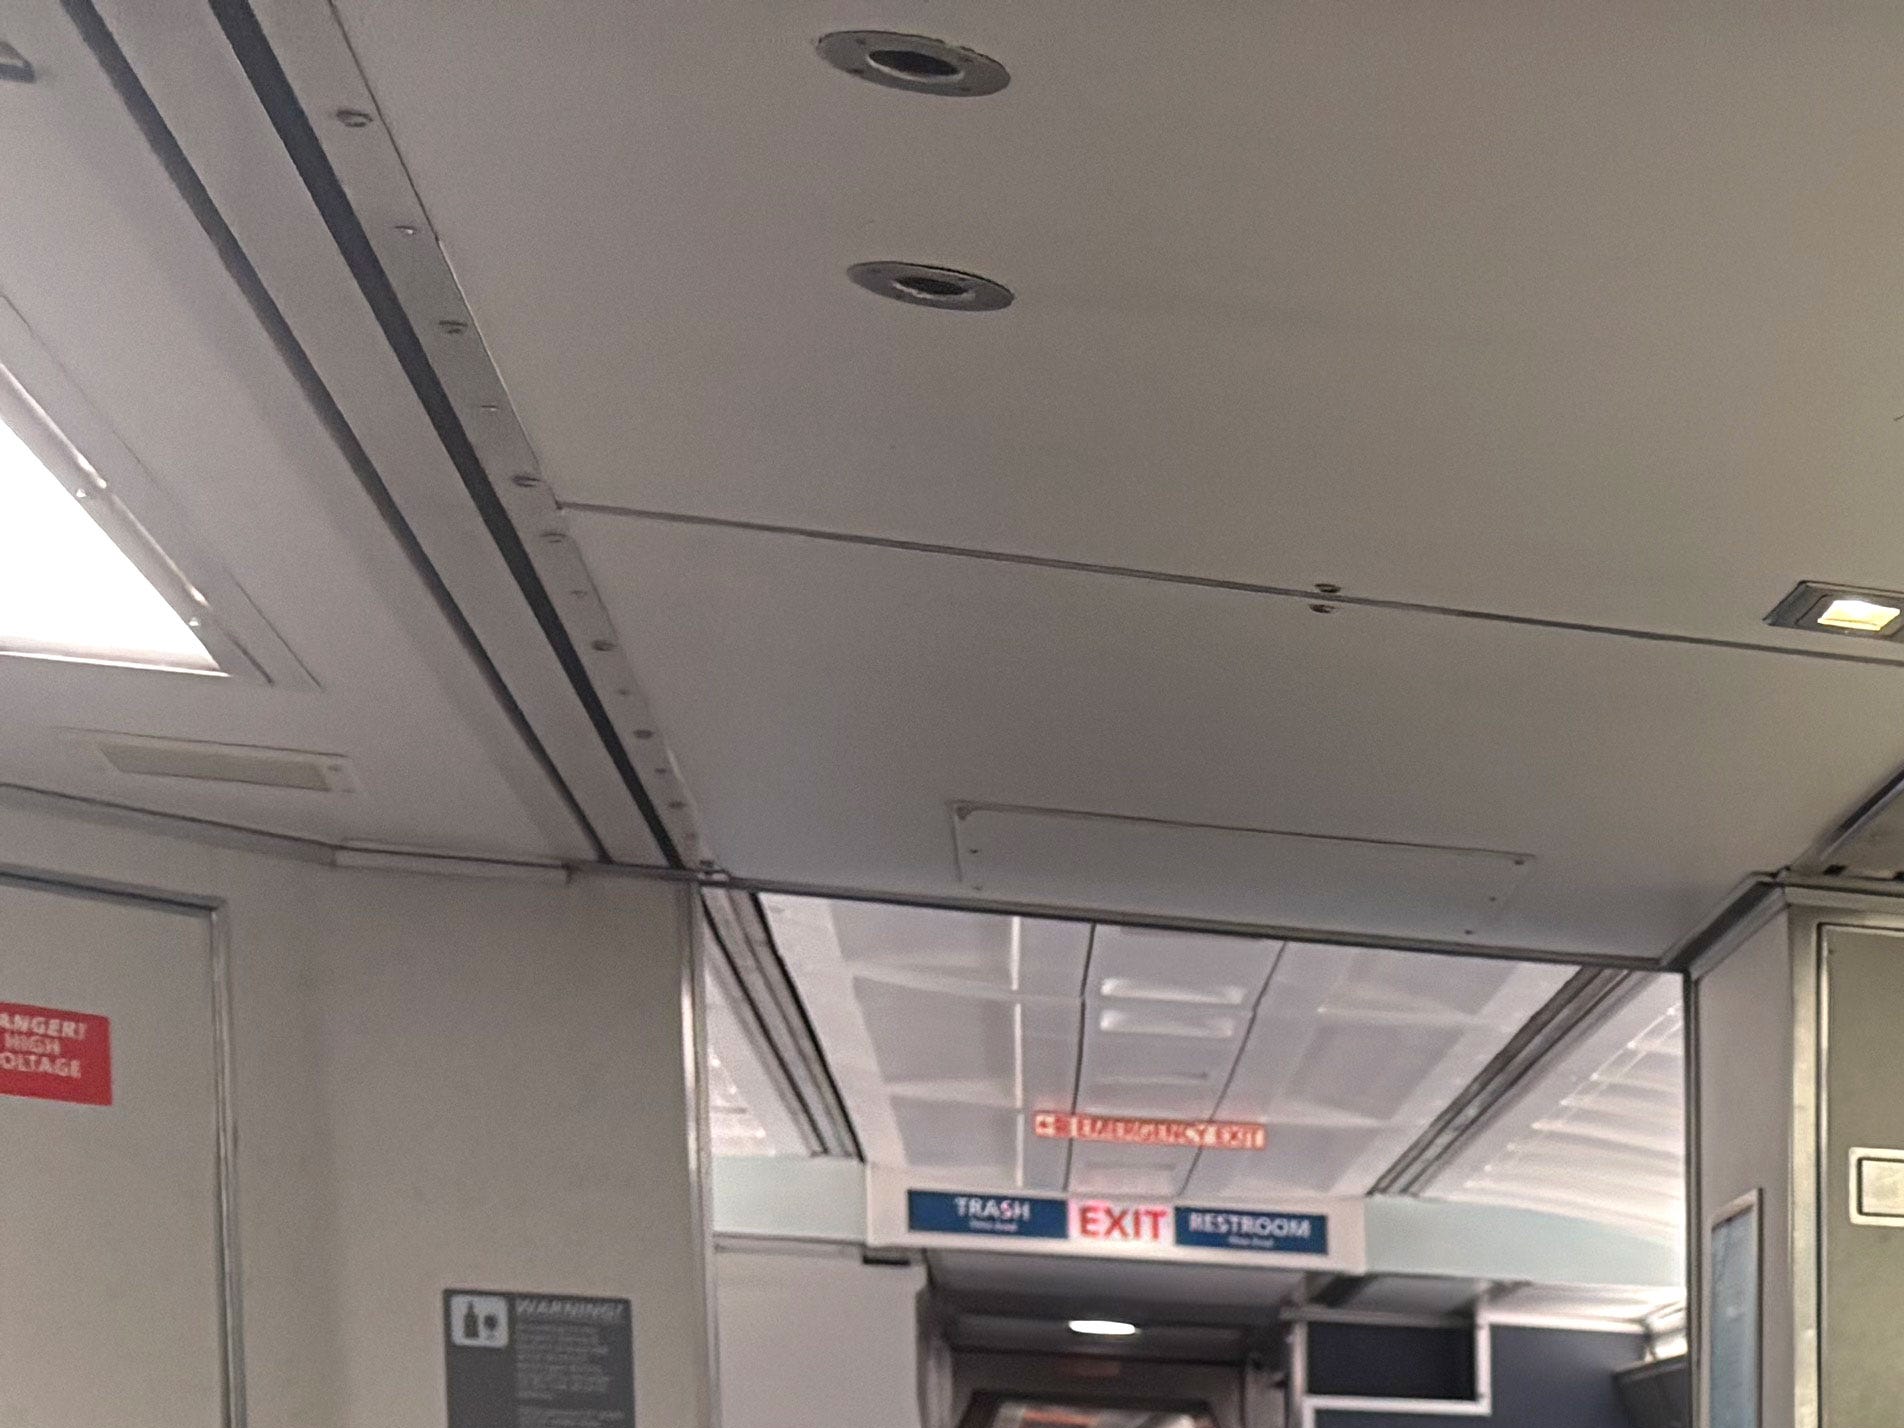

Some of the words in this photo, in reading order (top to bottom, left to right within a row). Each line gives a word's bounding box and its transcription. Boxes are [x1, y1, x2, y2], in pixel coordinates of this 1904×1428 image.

[0, 1012, 86, 1040] ANGER!
[5, 1033, 60, 1055] HIGH
[0, 1052, 81, 1078] OLTAGE
[955, 1197, 1030, 1221] TRASH
[1079, 1208, 1167, 1239] EXIT
[1189, 1212, 1310, 1238] RESTROOM
